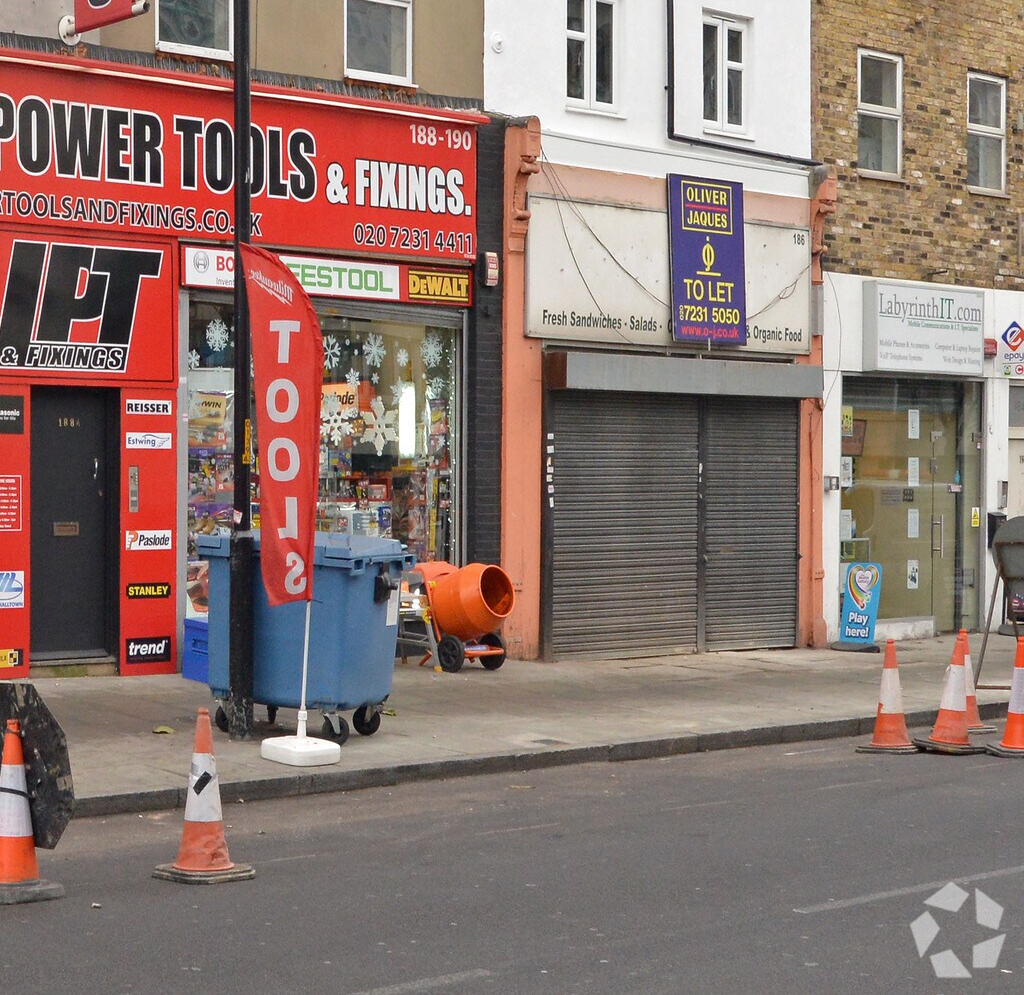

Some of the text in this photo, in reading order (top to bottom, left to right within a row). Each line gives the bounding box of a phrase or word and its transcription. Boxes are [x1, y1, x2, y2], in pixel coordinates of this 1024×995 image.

[410, 123, 472, 152] 188-190
[326, 162, 349, 205] &
[354, 158, 472, 217] FIXINGS.
[686, 186, 728, 206] OLIVER
[687, 210, 728, 229] JAQUES
[354, 222, 473, 255] 020 7231 4411
[792, 233, 806, 247] 186
[683, 278, 735, 303] TO LET
[684, 305, 708, 323] 7231
[711, 307, 741, 325] 5050
[878, 292, 982, 323] LabyrinthIT.com
[542, 309, 567, 328] Fresh
[570, 311, 622, 331] Sandwiches
[629, 315, 658, 333] Salads
[753, 324, 782, 345] Organic
[784, 328, 803, 343] Food
[681, 325, 740, 340] www.o-j.co.uk
[0, 344, 124, 370] & FIXINGS
[127, 403, 169, 414] REISSER
[127, 435, 157, 448] Estwing
[138, 534, 170, 547] Paslode
[128, 584, 169, 596] STANLEY
[849, 611, 869, 626] Play
[845, 626, 870, 638] here!
[129, 641, 165, 656] trend
